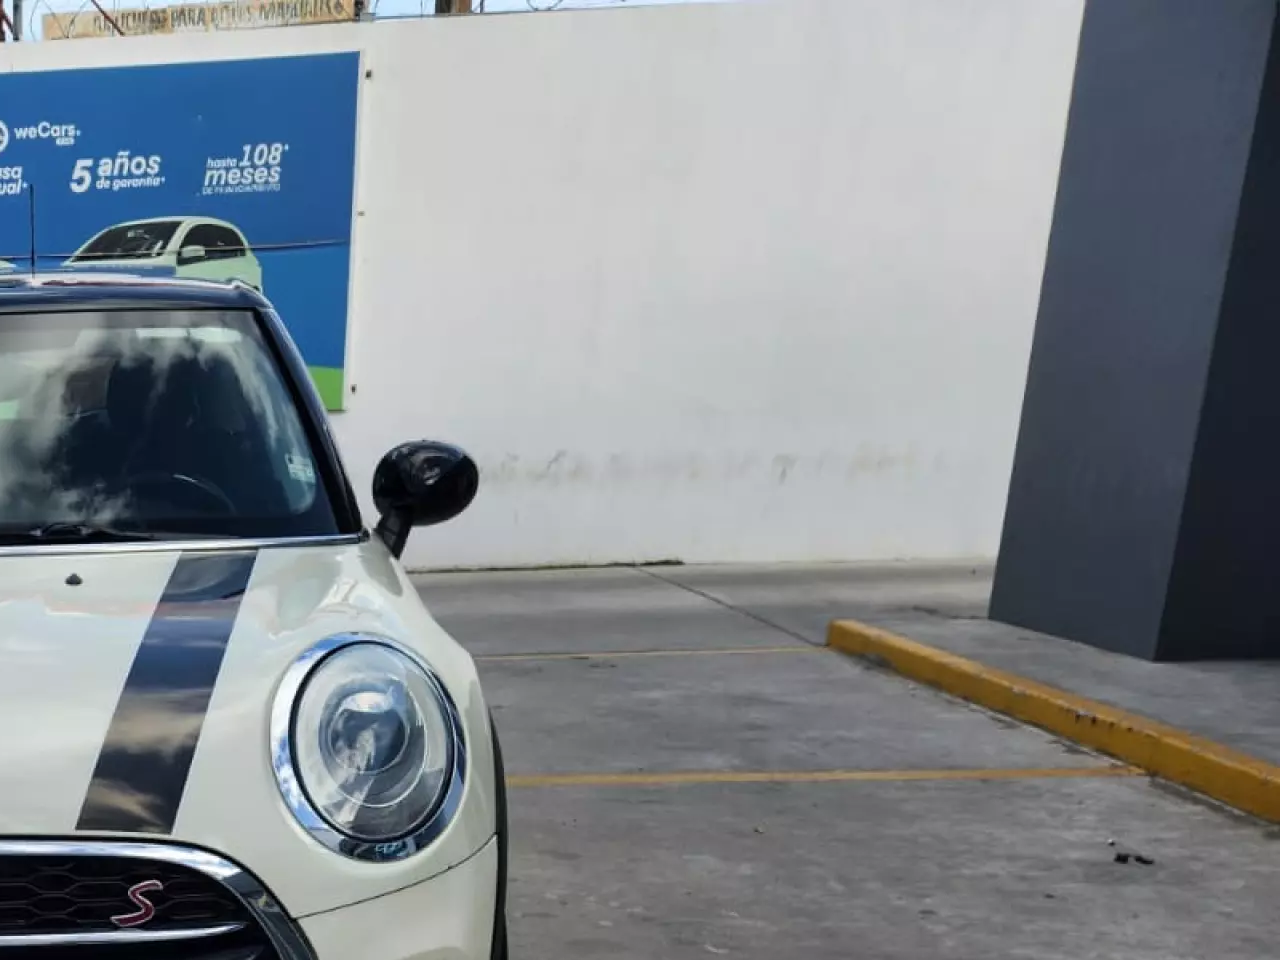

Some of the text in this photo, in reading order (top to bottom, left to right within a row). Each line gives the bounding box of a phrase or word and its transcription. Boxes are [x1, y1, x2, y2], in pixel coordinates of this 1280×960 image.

[69, 150, 161, 193] 5 años
[95, 177, 111, 190] de
[204, 165, 282, 187] meses
[110, 879, 163, 927] S
